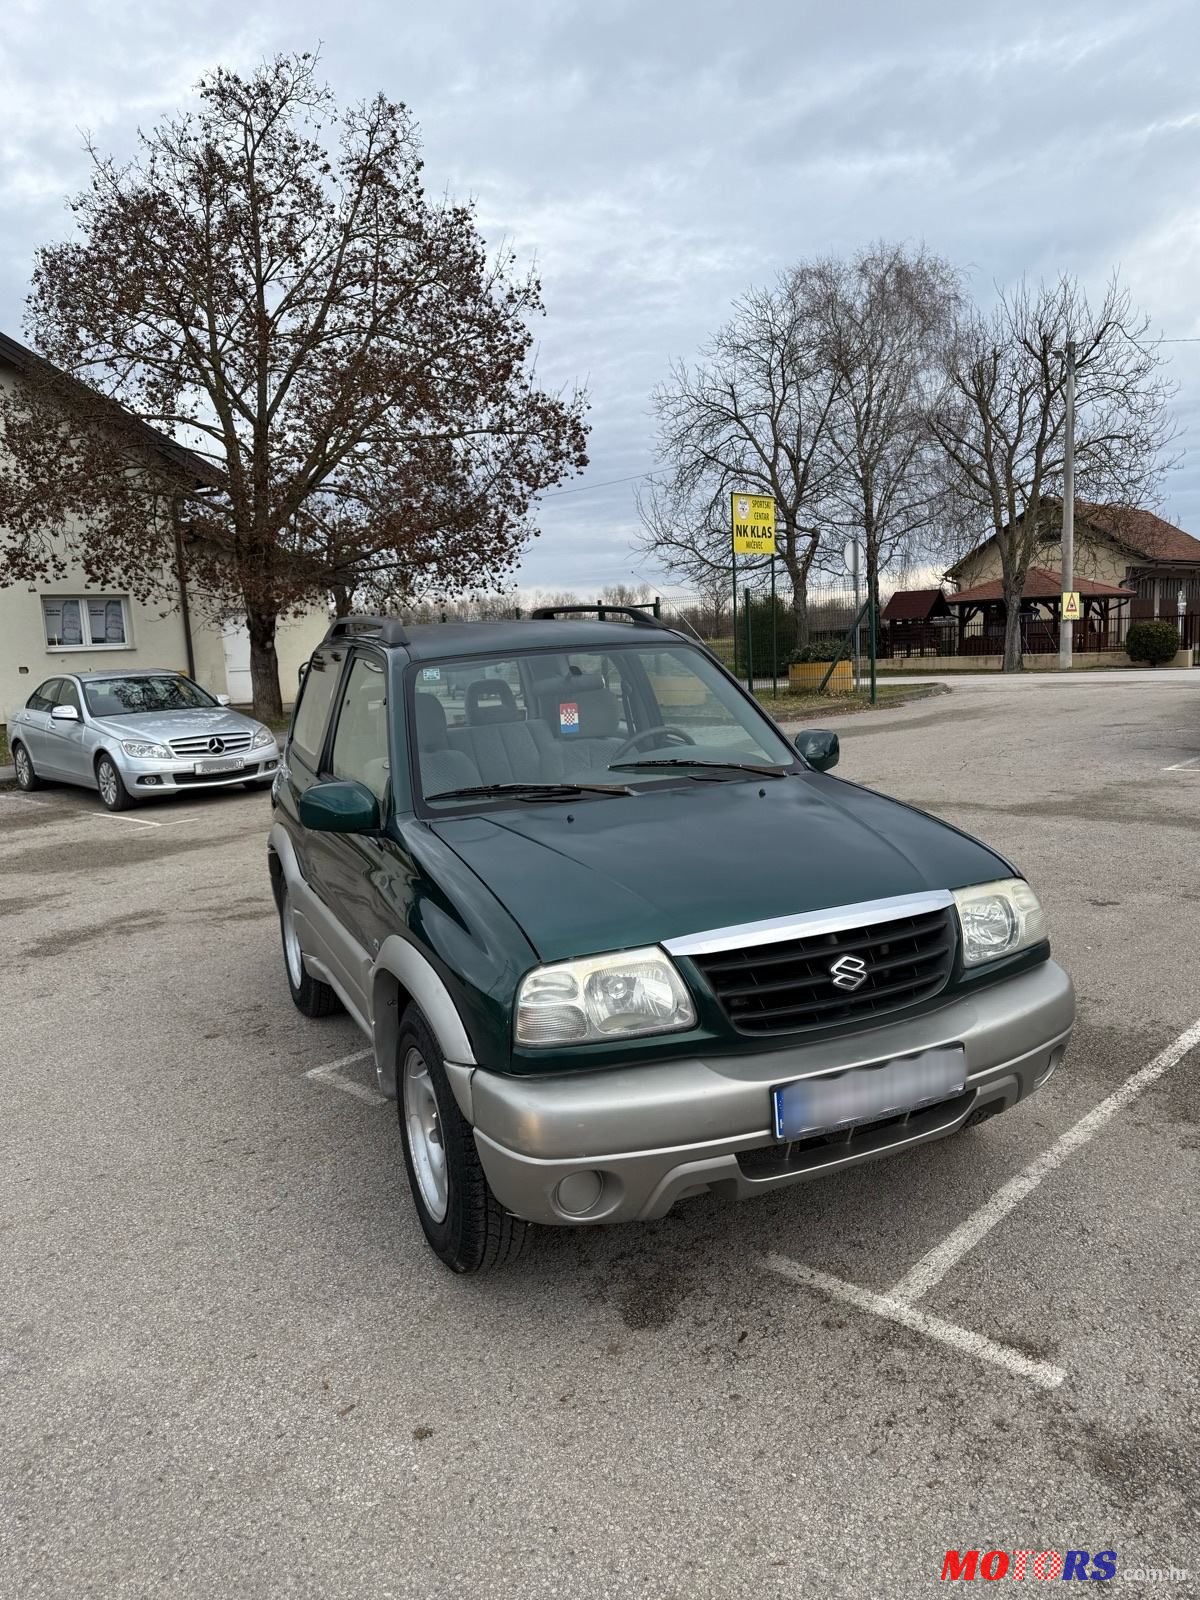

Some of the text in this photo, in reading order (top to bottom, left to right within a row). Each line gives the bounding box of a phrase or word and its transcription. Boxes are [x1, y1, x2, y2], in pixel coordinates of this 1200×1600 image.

[754, 512, 769, 520] CENTAR
[735, 524, 772, 538] NK KLAS
